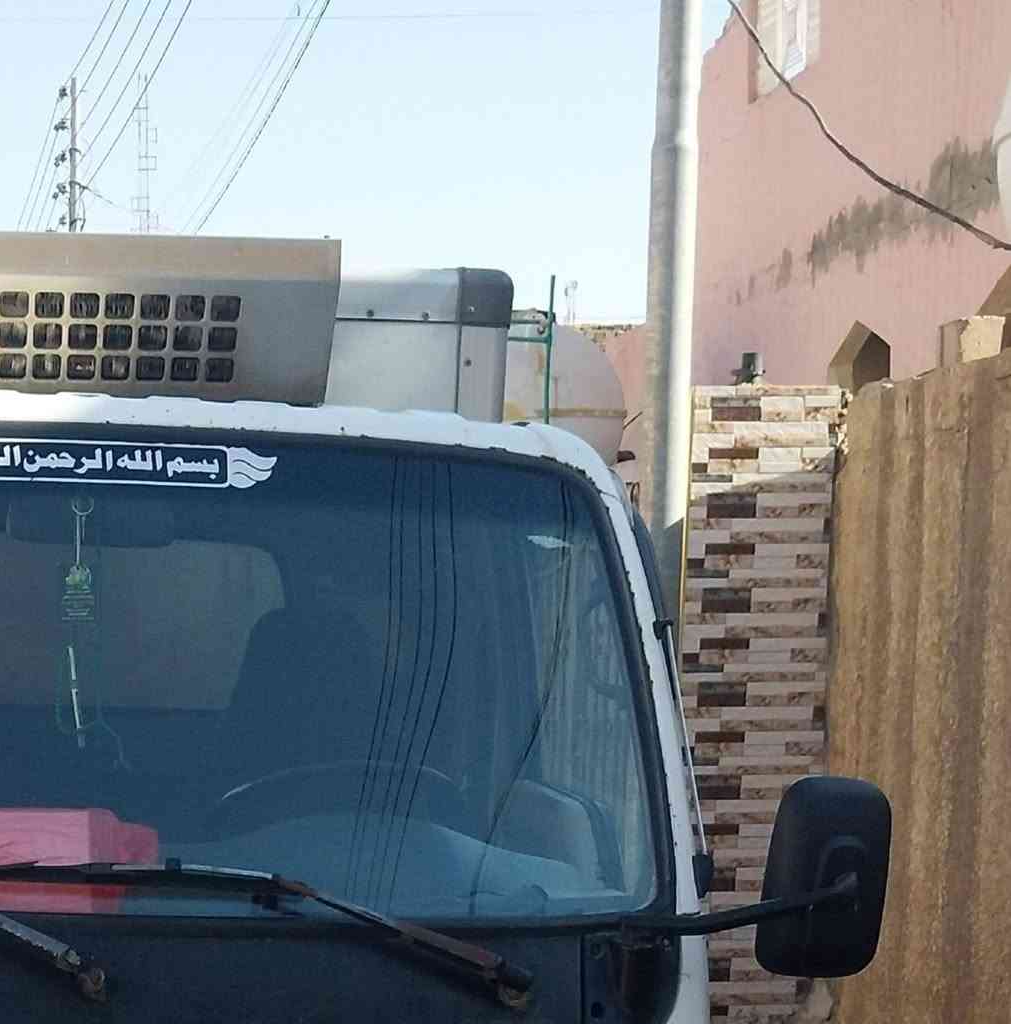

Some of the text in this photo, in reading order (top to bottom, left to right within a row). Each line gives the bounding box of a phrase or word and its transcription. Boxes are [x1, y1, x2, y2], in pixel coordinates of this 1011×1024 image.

[23, 447, 113, 474] الرحمن
[116, 449, 163, 471] الله
[166, 456, 220, 480] بسم
